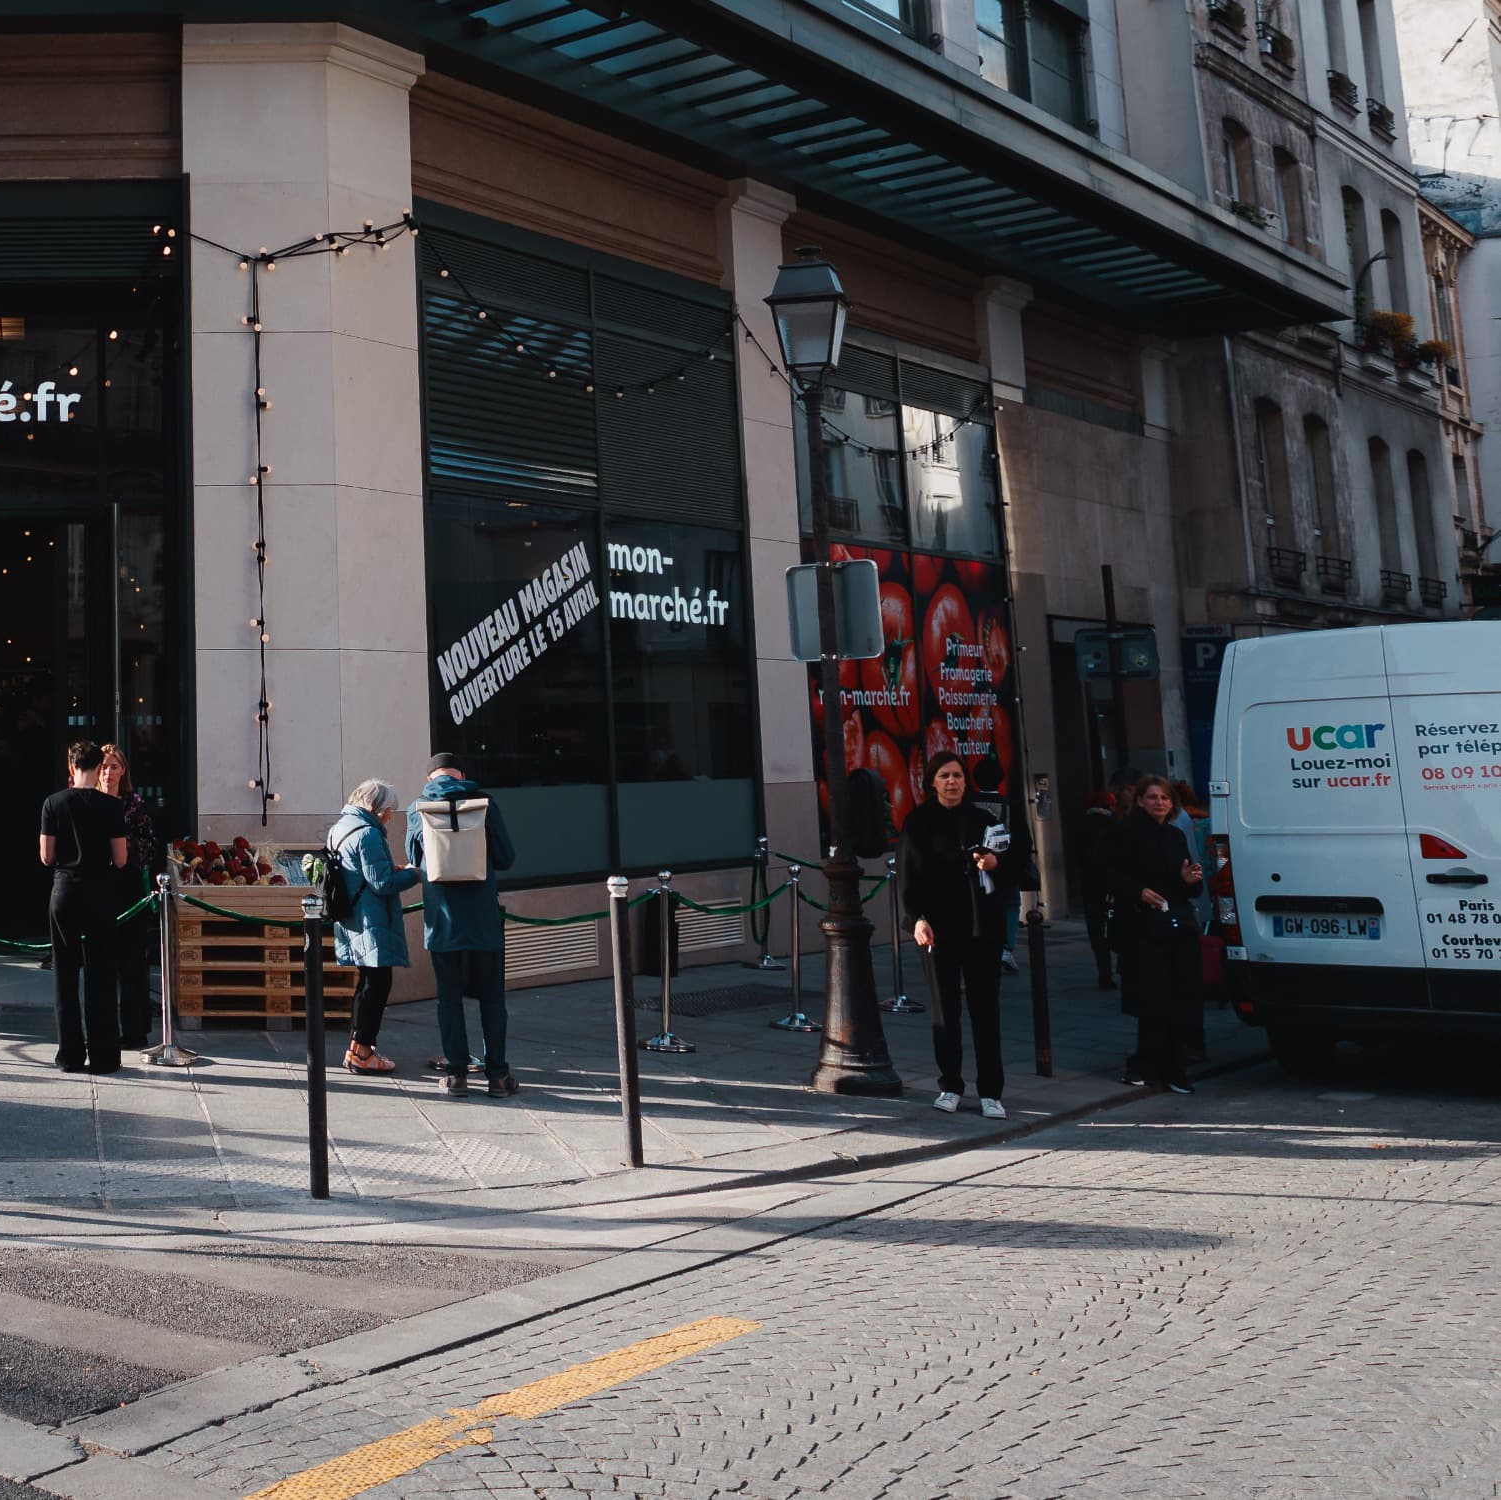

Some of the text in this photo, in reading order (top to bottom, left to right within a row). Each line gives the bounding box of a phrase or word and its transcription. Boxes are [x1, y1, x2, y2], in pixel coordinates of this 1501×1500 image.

[607, 542, 674, 575] mon-
[609, 586, 729, 626] marché.fr
[436, 541, 591, 692] NOUVEAU MAGASIN
[449, 580, 600, 726] OUVERTURE LE 15 AVRIL
[945, 637, 984, 658] Primeur
[939, 662, 994, 687] Fromagerie
[819, 681, 911, 707] n-marché.fr
[938, 686, 998, 706] Poissonnerie
[946, 712, 994, 731] Boucherie
[1415, 722, 1500, 737] Réservez
[952, 737, 991, 756] Traiteur
[1286, 723, 1387, 752] ucar
[1418, 743, 1450, 758] par
[1290, 753, 1392, 771] Louez-moi
[1292, 772, 1391, 789] sur ucar.fr
[1421, 764, 1501, 780] 08 09 10
[1459, 899, 1495, 911] Paris
[1284, 918, 1367, 936] GW-096-LW
[1427, 913, 1442, 924] 01
[1448, 913, 1467, 924] 48
[1470, 913, 1489, 924] 78
[1432, 947, 1494, 960] 01 55 70
